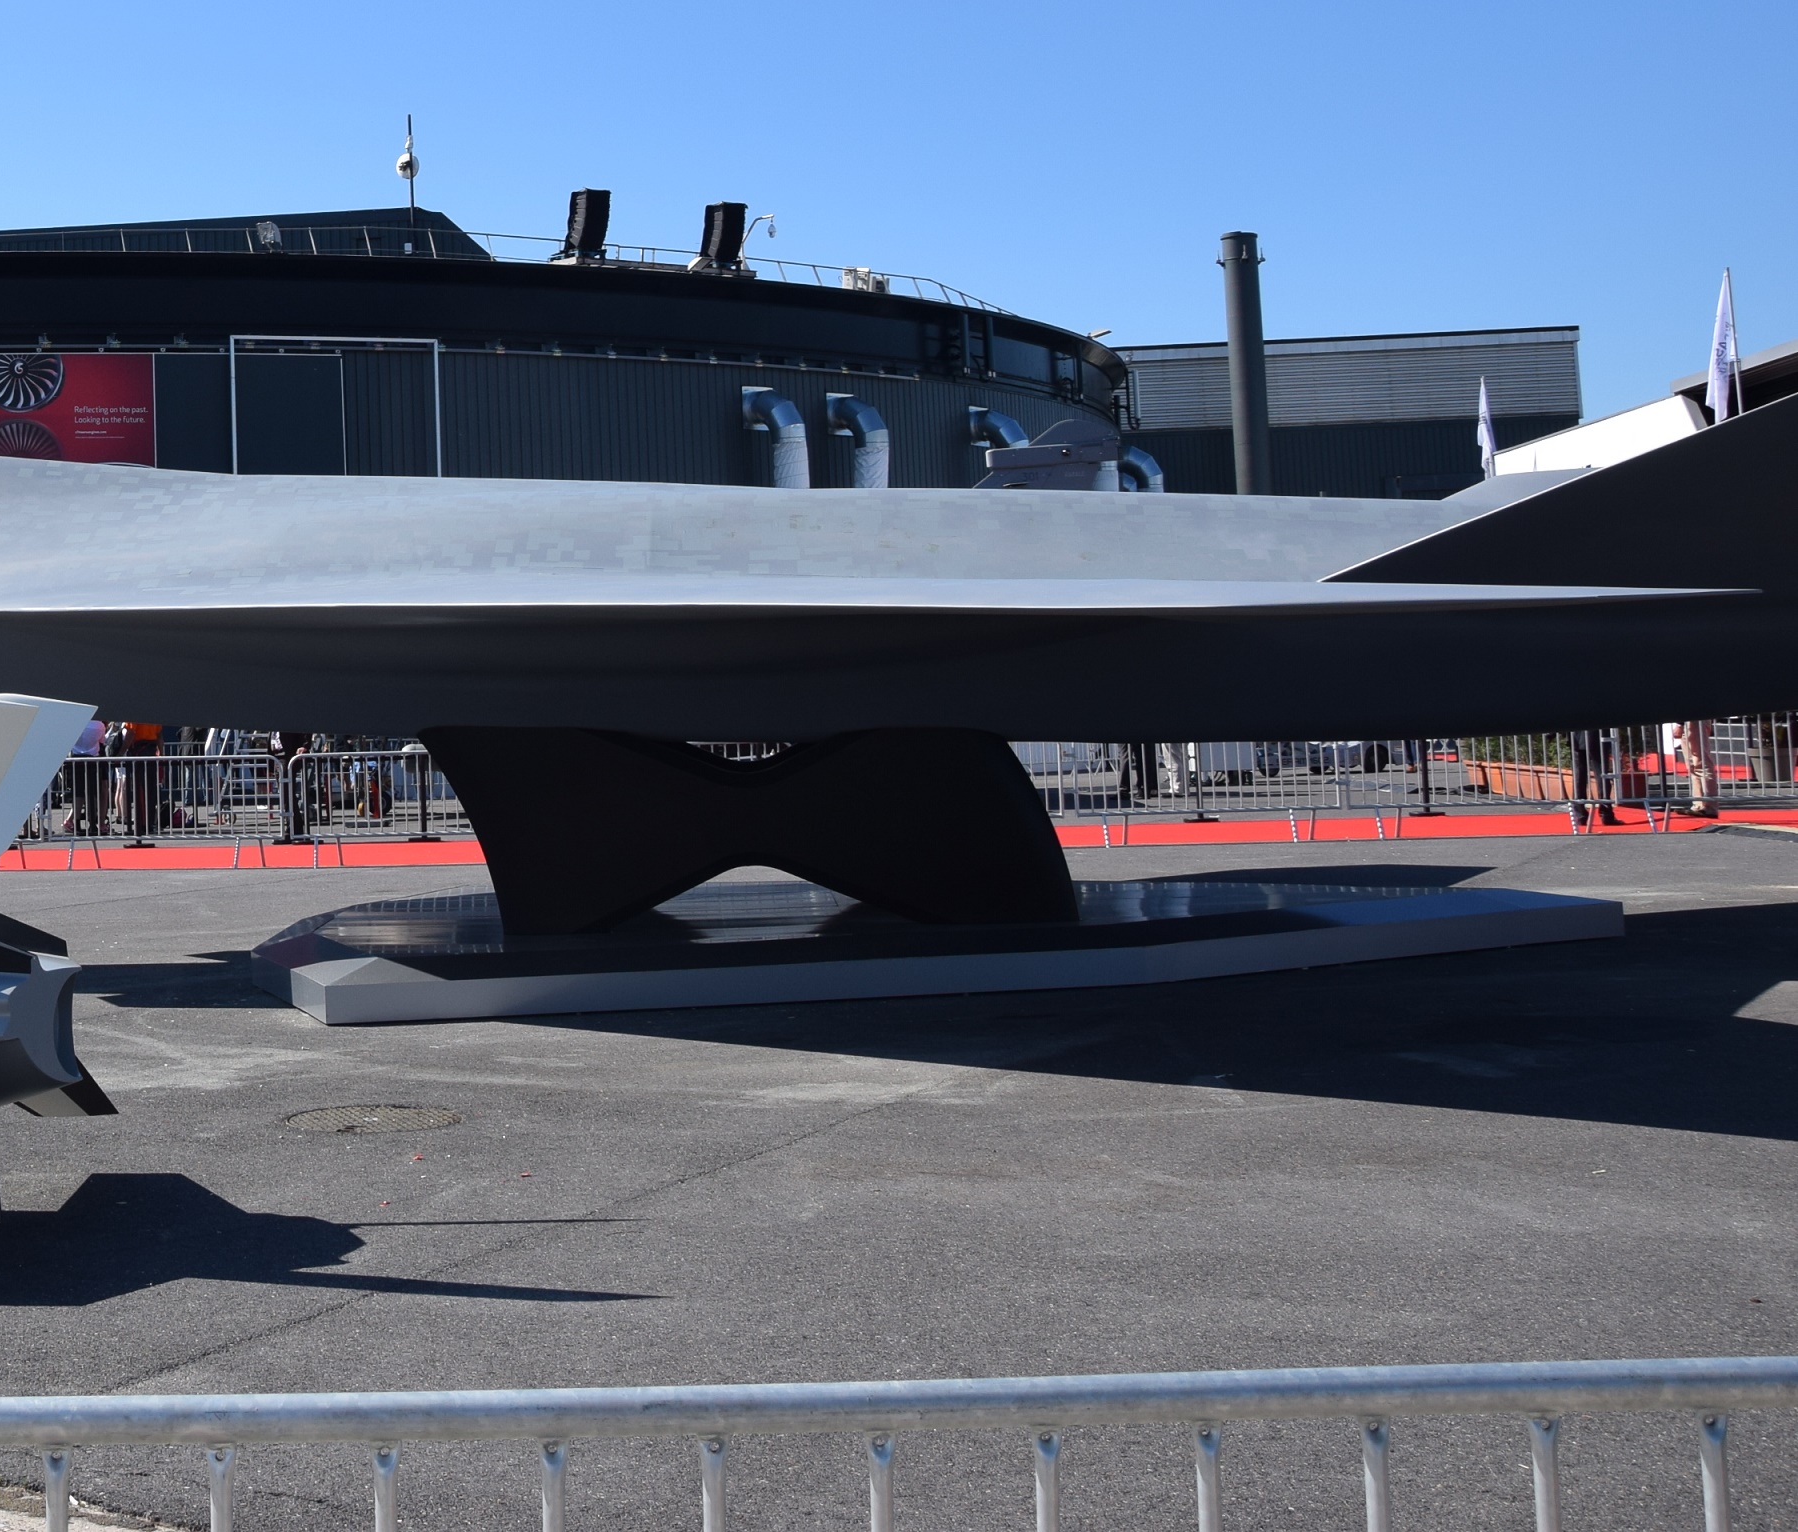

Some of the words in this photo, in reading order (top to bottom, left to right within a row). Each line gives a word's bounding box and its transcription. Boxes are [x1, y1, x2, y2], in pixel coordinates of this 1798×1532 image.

[74, 405, 109, 415] Reflecting
[119, 405, 130, 414] the
[74, 416, 101, 425] Looking
[110, 415, 122, 423] the
